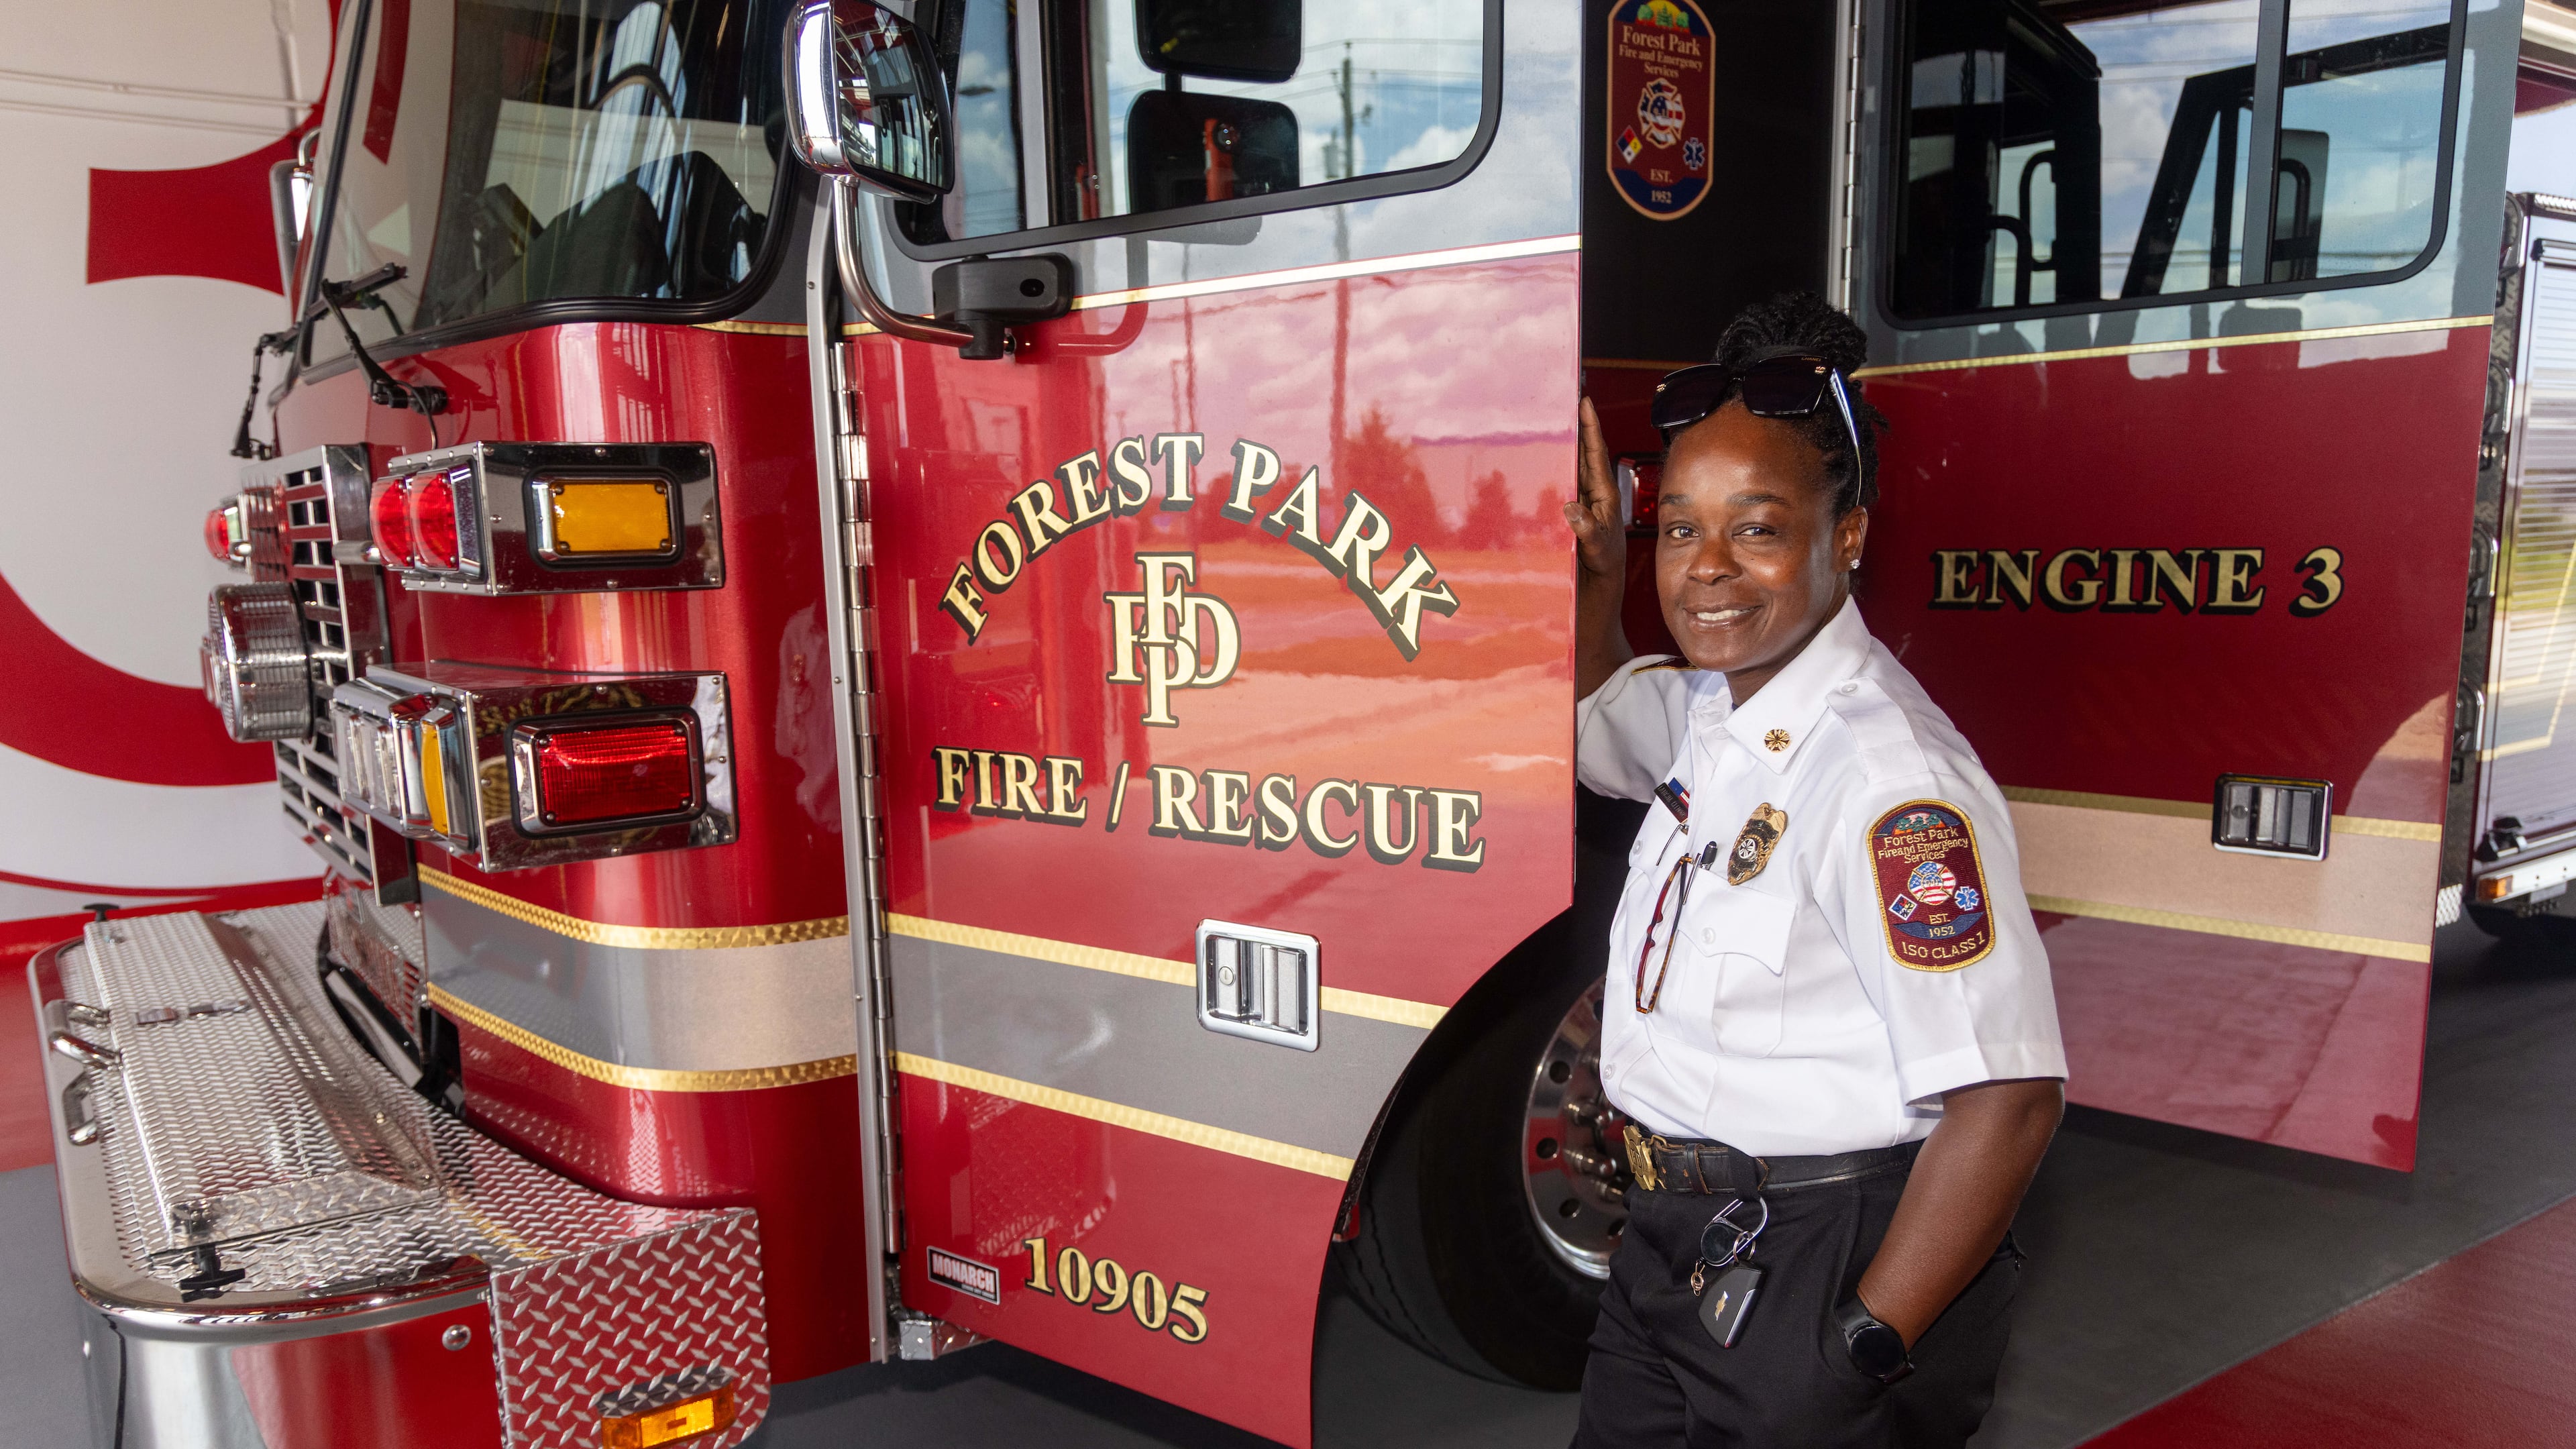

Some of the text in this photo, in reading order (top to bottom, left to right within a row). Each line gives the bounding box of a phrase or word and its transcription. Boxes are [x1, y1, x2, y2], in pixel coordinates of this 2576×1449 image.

[1623, 25, 1701, 56] Forest Park
[1619, 44, 1703, 72] Fire and Emergency
[1644, 62, 1679, 78] Services
[1650, 168, 1673, 183] EST.
[1651, 190, 1672, 204] 1952
[938, 433, 1458, 661] FOREST PARK
[1929, 546, 2344, 617] ENGINE 3
[934, 747, 1486, 873] FIRE / RESCUE
[1884, 826, 1959, 849] Forest Park
[1917, 838, 1969, 852] Emergency
[1904, 850, 1945, 864] Services
[1929, 913, 1951, 924] EST.
[1902, 930, 1986, 959] ISO CLASS 1
[1929, 926, 1955, 938] 1952
[932, 1252, 996, 1294] MONARCH
[1024, 1237, 1209, 1344] 10905
